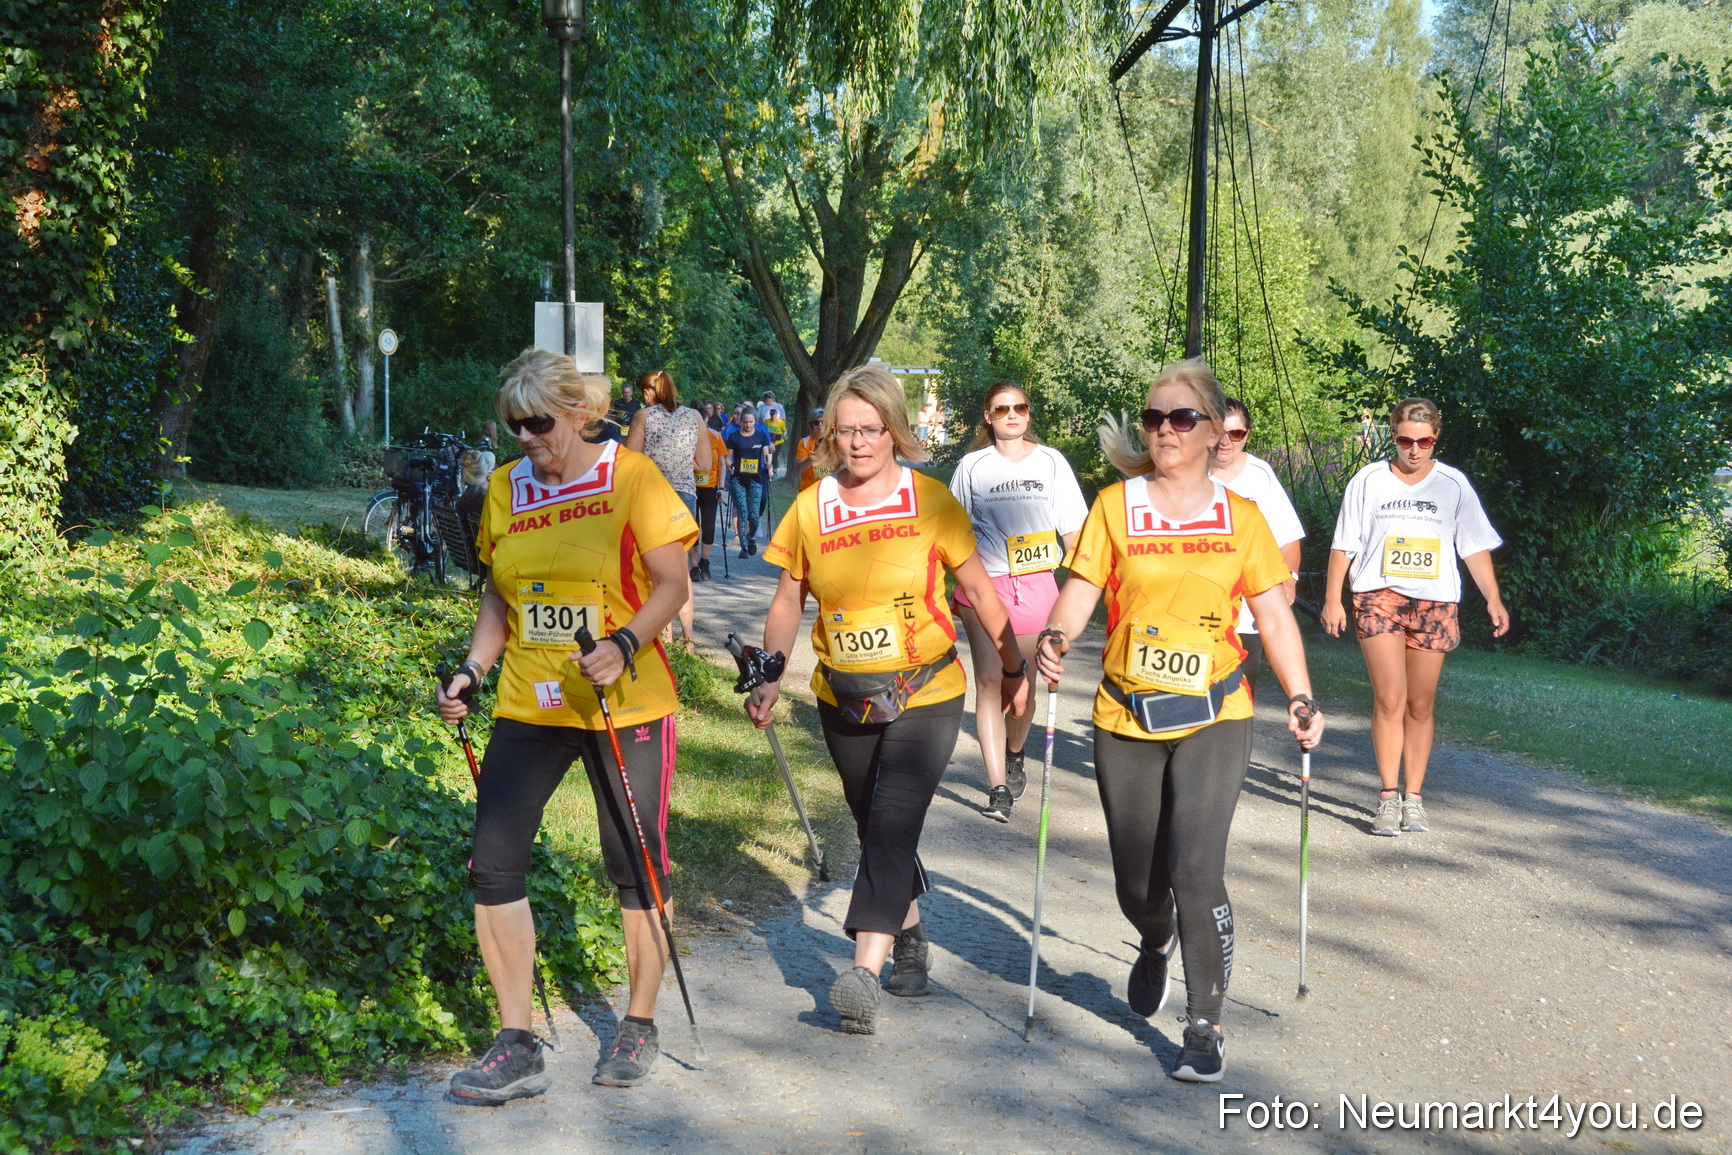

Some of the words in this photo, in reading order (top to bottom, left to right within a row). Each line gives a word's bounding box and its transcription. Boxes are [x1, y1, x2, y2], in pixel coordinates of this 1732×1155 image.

[984, 495, 1016, 504] Waldkalkung
[507, 512, 553, 535] MAX
[558, 500, 614, 524] BÖGL
[820, 532, 862, 555] MAX
[868, 523, 920, 543] BÖGL
[1126, 542, 1175, 557] MAX
[1181, 538, 1237, 555] BÖGL
[1014, 544, 1049, 564] 2041
[1390, 550, 1433, 567] 2038
[528, 604, 588, 630] 1301
[834, 627, 892, 653] 1302
[859, 649, 884, 660] Irmgard
[1138, 645, 1201, 677] 1300
[1141, 667, 1161, 678] Fuchs
[1161, 673, 1192, 684] Angelika
